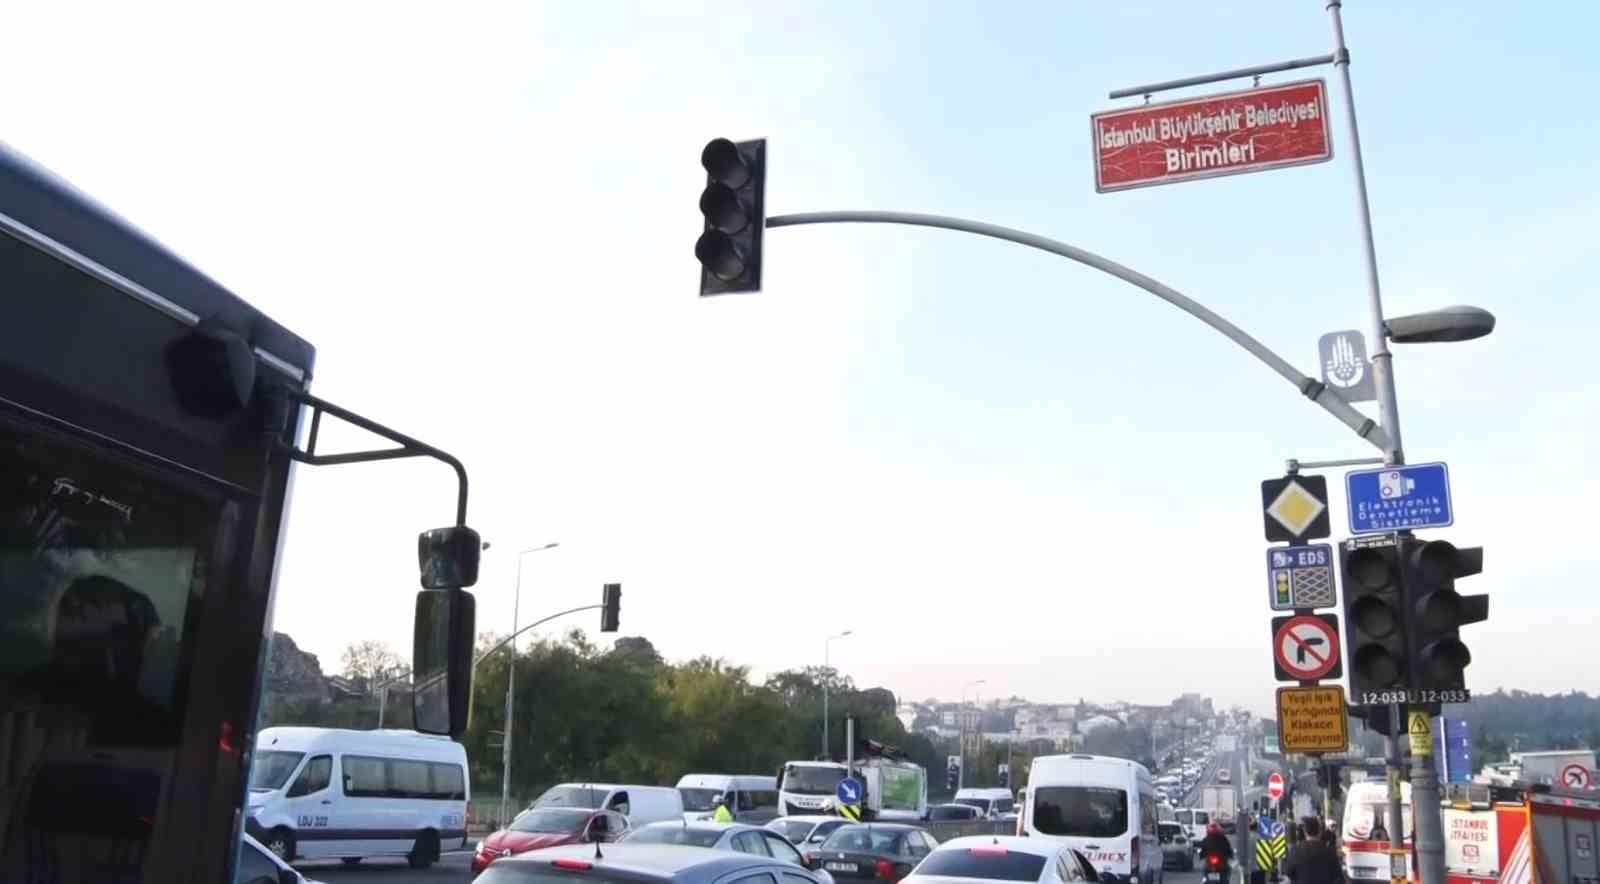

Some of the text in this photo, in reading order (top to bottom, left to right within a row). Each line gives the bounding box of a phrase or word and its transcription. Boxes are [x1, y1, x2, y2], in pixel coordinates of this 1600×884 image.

[1100, 97, 1320, 149] İstanbul Büyükşehir Belediyesi
[1165, 139, 1255, 172] Birimleri
[1359, 496, 1440, 512] Elektronik
[1359, 506, 1441, 520] Denetleme
[1371, 516, 1430, 529] Sistemi
[1298, 551, 1325, 566] EDS
[1362, 690, 1407, 704] 12-033
